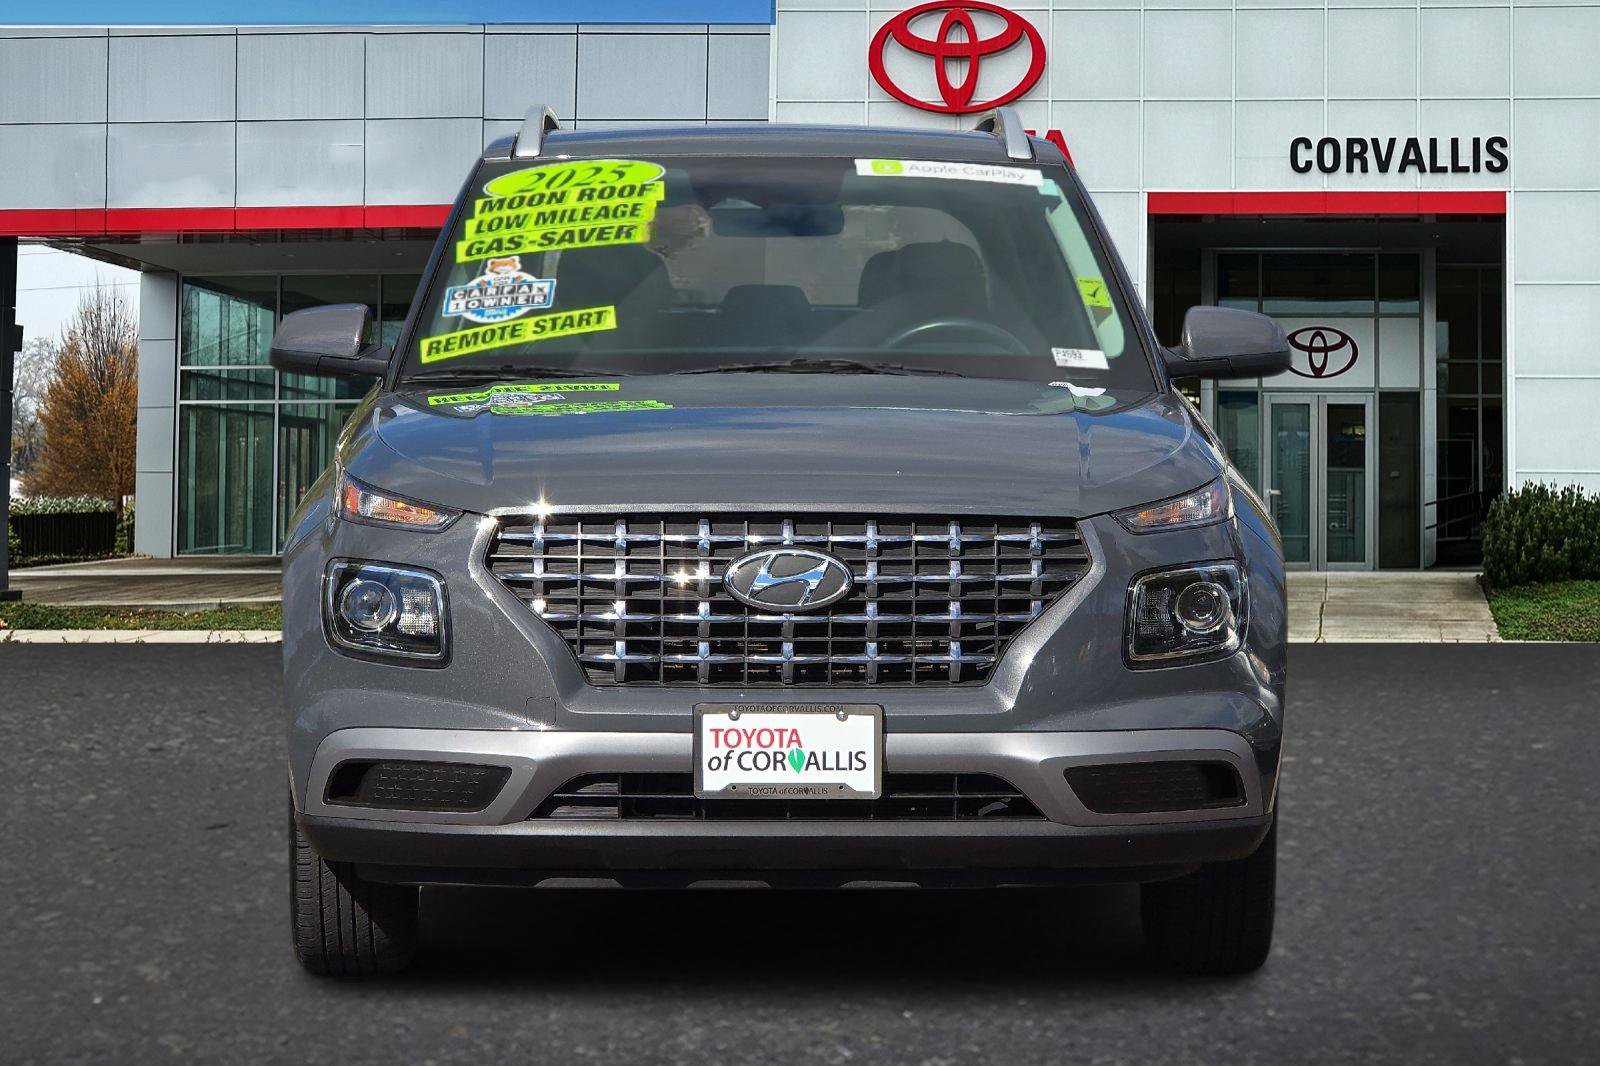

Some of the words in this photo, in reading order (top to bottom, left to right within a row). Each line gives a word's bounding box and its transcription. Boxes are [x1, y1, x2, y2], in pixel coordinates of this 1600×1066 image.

[1290, 136, 1509, 173] CORVALLIS
[517, 163, 634, 193] 2025
[908, 163, 958, 175] Apple
[962, 166, 1025, 181] CarPlay
[478, 190, 568, 215] MOON
[577, 182, 655, 203] ROOF
[474, 214, 529, 235] LOW
[534, 202, 645, 226] MILEAGE
[464, 224, 640, 258] GAS-SAVER
[453, 284, 547, 299] CARFAX
[426, 323, 524, 357] REMOTE
[532, 309, 610, 335] START
[734, 705, 844, 713] TOYOTAOFCORVALLIS.COM
[709, 728, 803, 748] TOYOTA
[707, 750, 734, 771] of
[737, 748, 867, 774] CORVALLIS
[748, 787, 778, 795] TOYOTA
[779, 787, 788, 795] of
[789, 786, 828, 795] CORVALLIS
